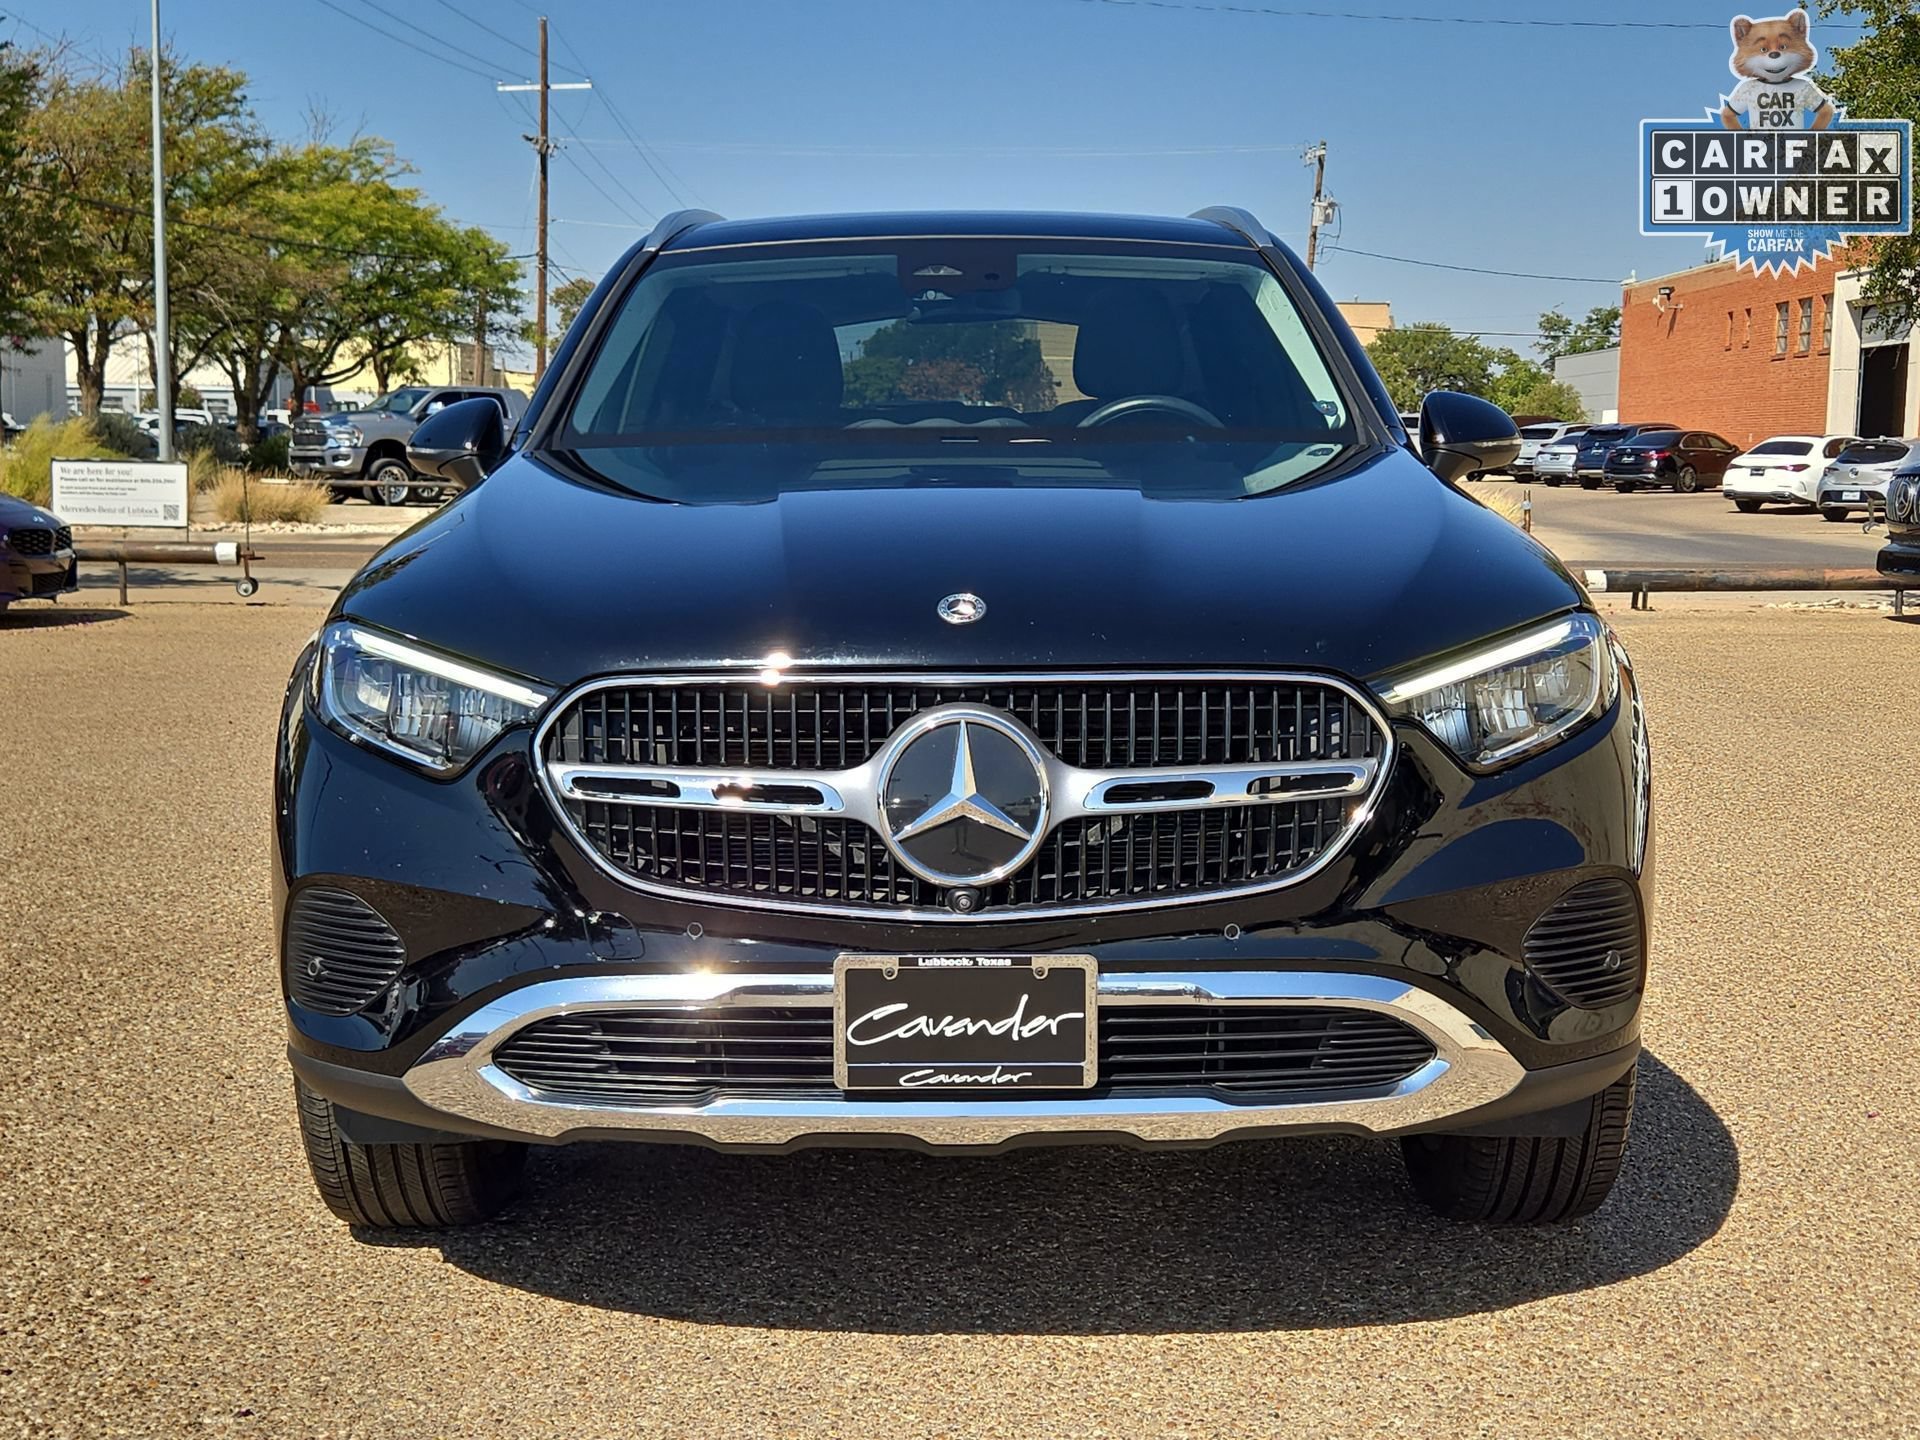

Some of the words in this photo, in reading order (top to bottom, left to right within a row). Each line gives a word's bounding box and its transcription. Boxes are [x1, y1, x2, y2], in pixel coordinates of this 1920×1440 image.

[60, 466, 71, 475] We
[86, 466, 102, 475] here
[104, 467, 116, 475] for
[60, 504, 117, 514] Mercedes-Benz
[118, 505, 126, 514] of
[127, 505, 159, 515] Lubbock
[917, 957, 974, 967] Lubbock,
[975, 957, 1012, 966] Texas
[846, 993, 1085, 1046] Cavender
[899, 1065, 1033, 1087] Cavender
